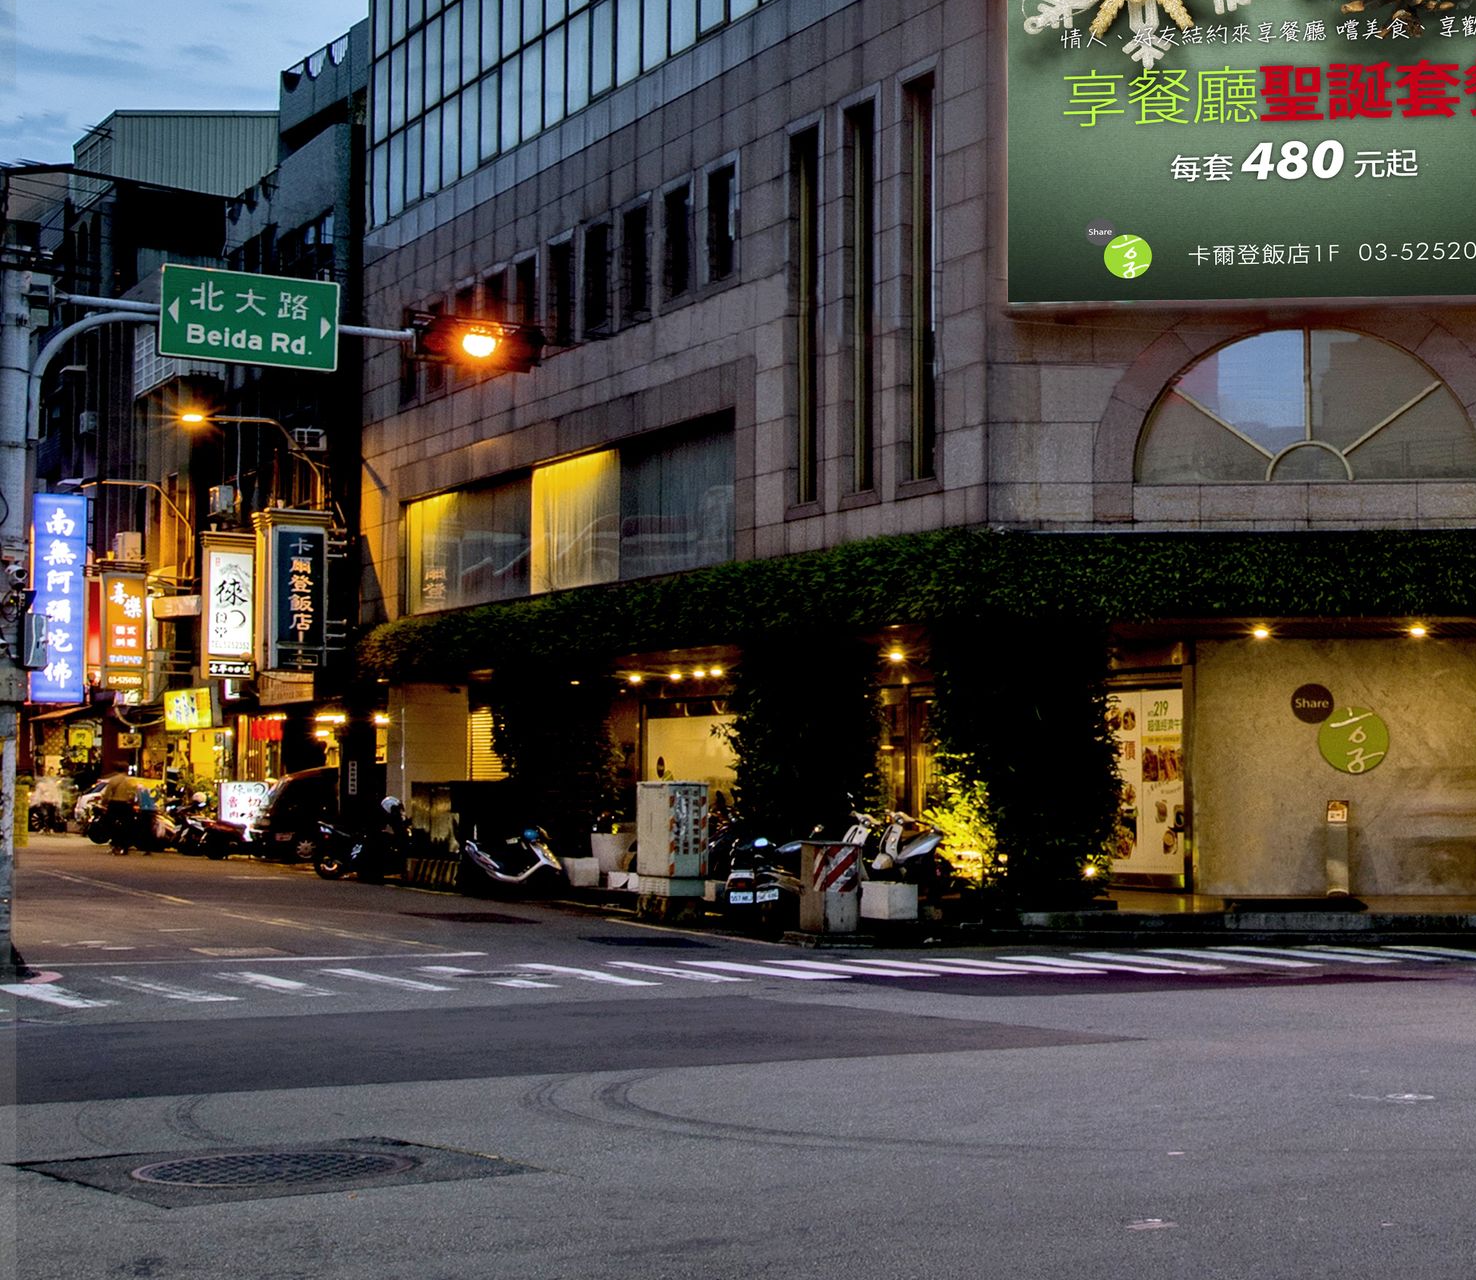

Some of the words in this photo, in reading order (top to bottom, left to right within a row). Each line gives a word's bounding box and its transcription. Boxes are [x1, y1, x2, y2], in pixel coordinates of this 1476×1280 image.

[1170, 152, 1235, 183] 每套
[1241, 140, 1344, 181] 480
[1354, 149, 1418, 179] 元起
[1088, 227, 1113, 237] Share
[190, 280, 308, 323] 北大路
[186, 323, 263, 349] Beida
[270, 333, 313, 357] Rd.
[289, 538, 314, 631] 卡爾登飯店
[1295, 698, 1330, 708] Share
